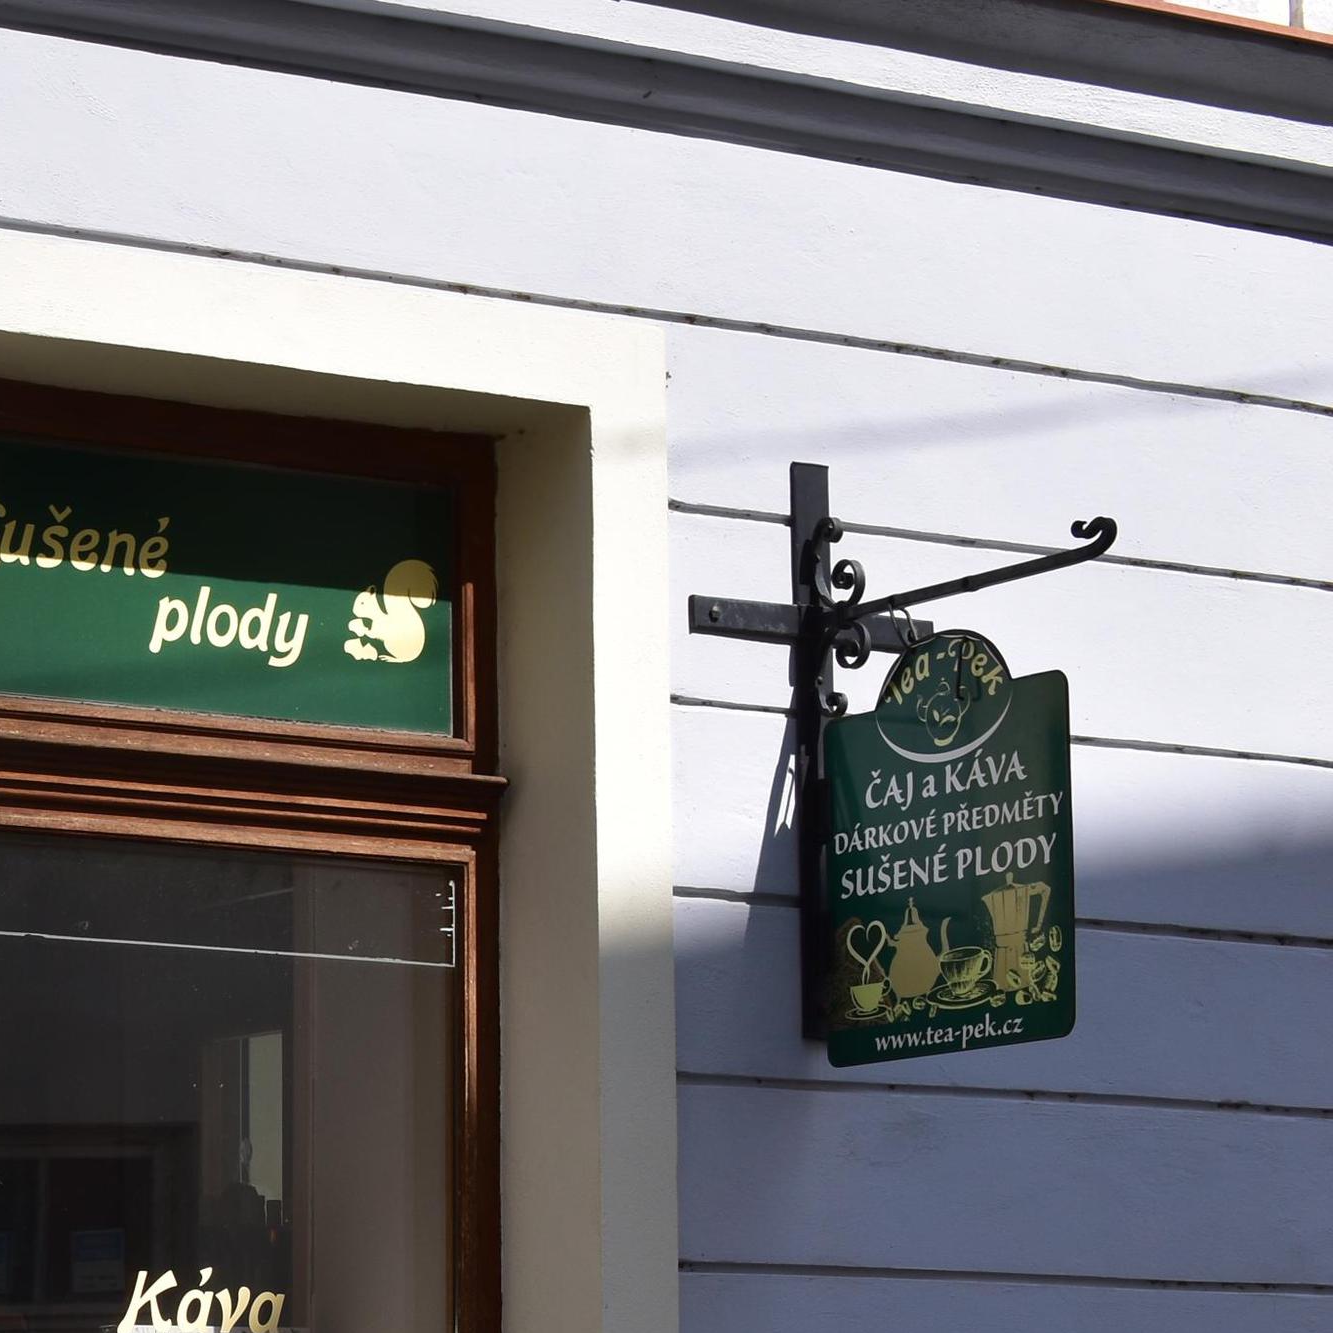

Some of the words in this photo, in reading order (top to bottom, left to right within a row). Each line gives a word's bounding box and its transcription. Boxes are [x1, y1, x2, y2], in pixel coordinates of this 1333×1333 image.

[148, 586, 309, 667] plody
[865, 769, 914, 811] ČAJ
[922, 774, 938, 798] a
[944, 748, 1028, 794] KÁVA
[833, 809, 938, 855] DÁRKOVÉ
[942, 790, 1063, 835] PŘEDMĚTY
[840, 843, 949, 899] SUŠENÉ
[956, 832, 1057, 880] PLODY
[874, 1012, 1024, 1052] www.tea-pek.cz
